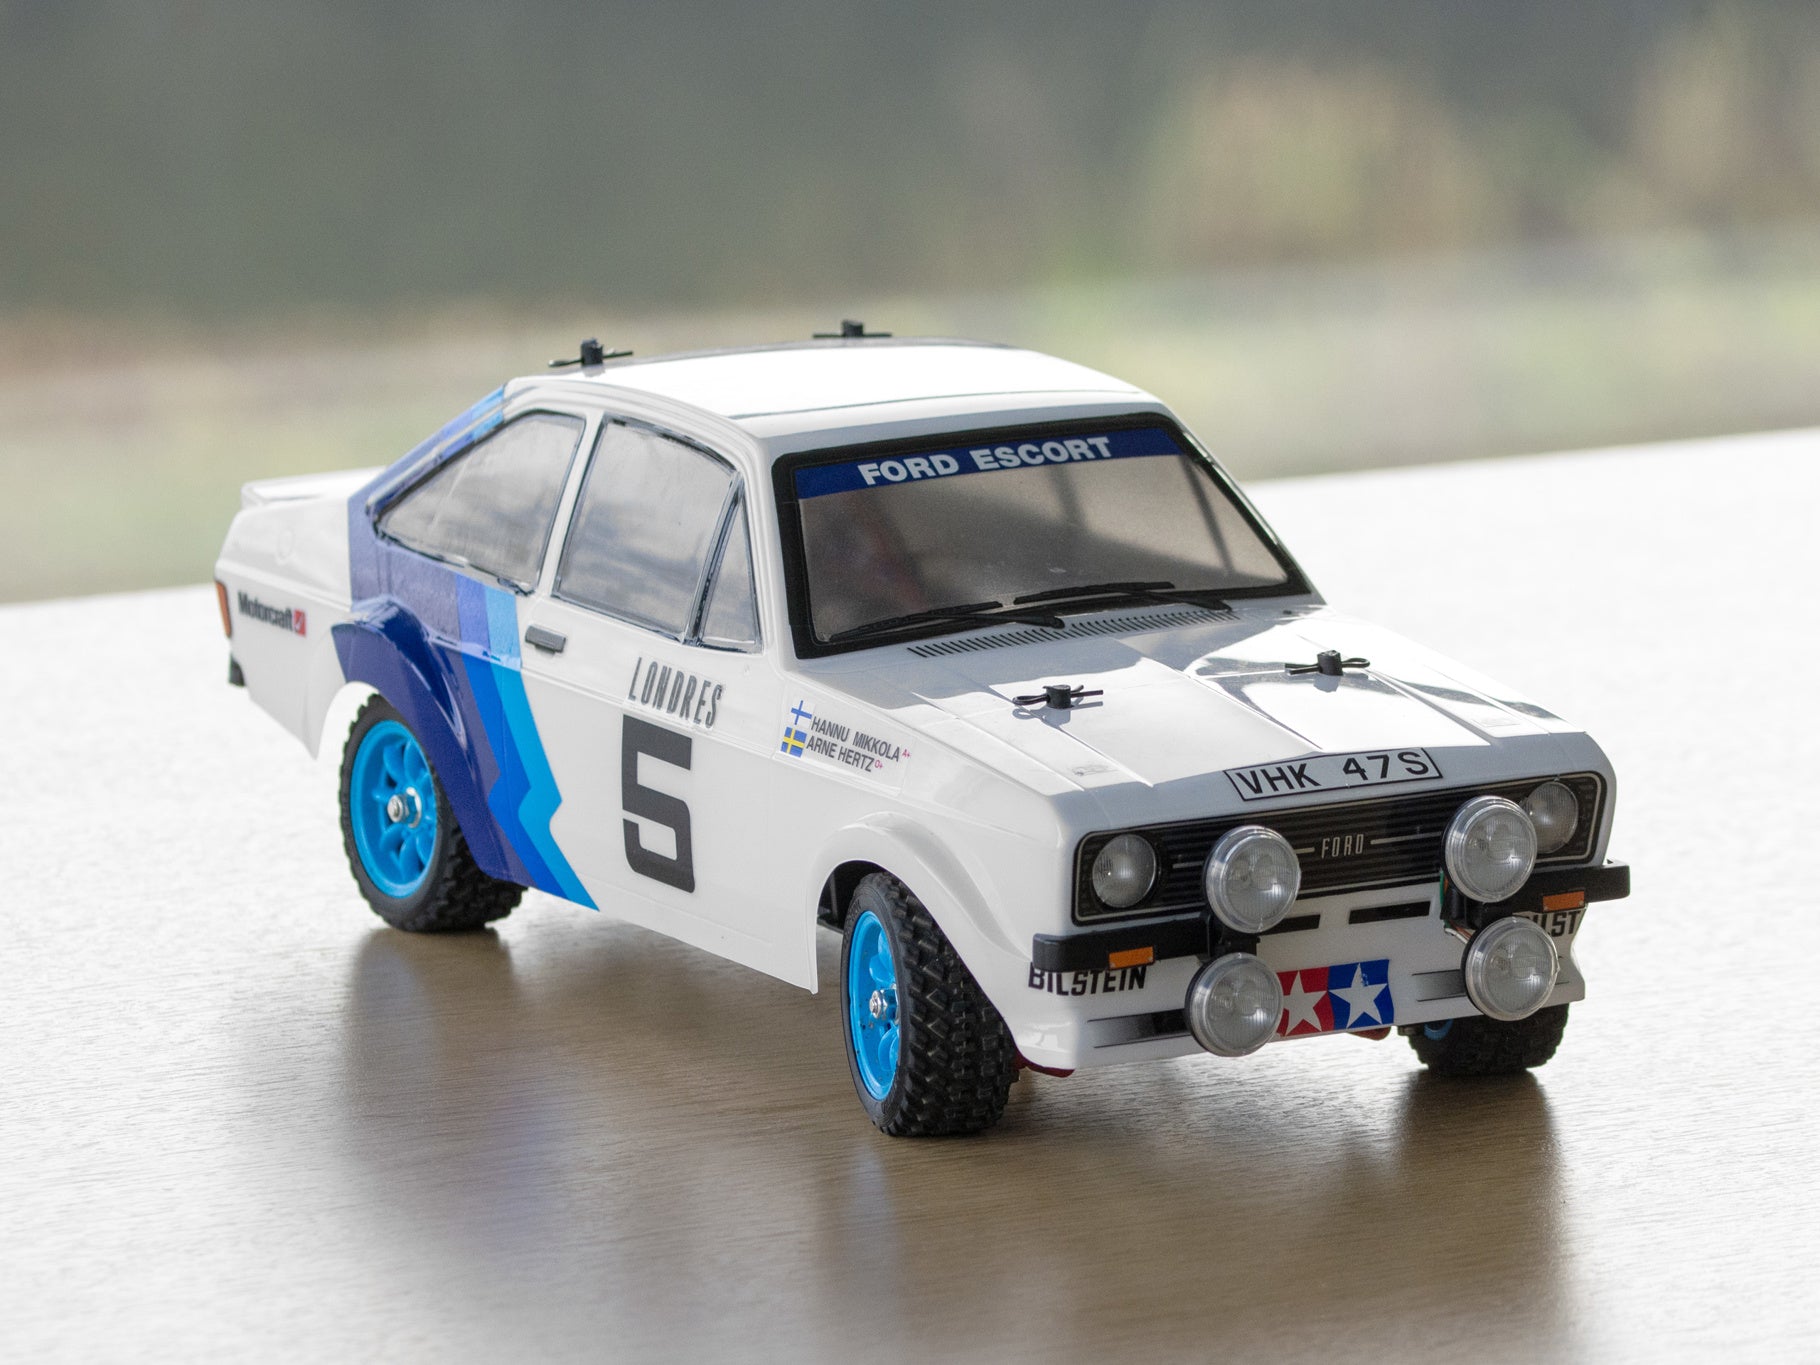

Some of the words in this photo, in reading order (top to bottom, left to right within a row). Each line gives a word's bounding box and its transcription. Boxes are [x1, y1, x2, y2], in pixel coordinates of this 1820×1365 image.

[857, 454, 960, 486] FORD
[969, 436, 1113, 470] ESCORT
[238, 590, 293, 633] Motorcraft
[627, 656, 723, 729] LONDRES
[806, 735, 838, 759] ARNE
[837, 746, 875, 773] HERTZ
[811, 716, 850, 742] HANNU
[852, 731, 900, 762] MIKKOLA
[1235, 763, 1322, 795] VHK
[1342, 751, 1430, 781] 47S
[621, 714, 695, 894] 5
[1320, 834, 1365, 859] FORD
[1028, 962, 1147, 996] BILSTEIN
